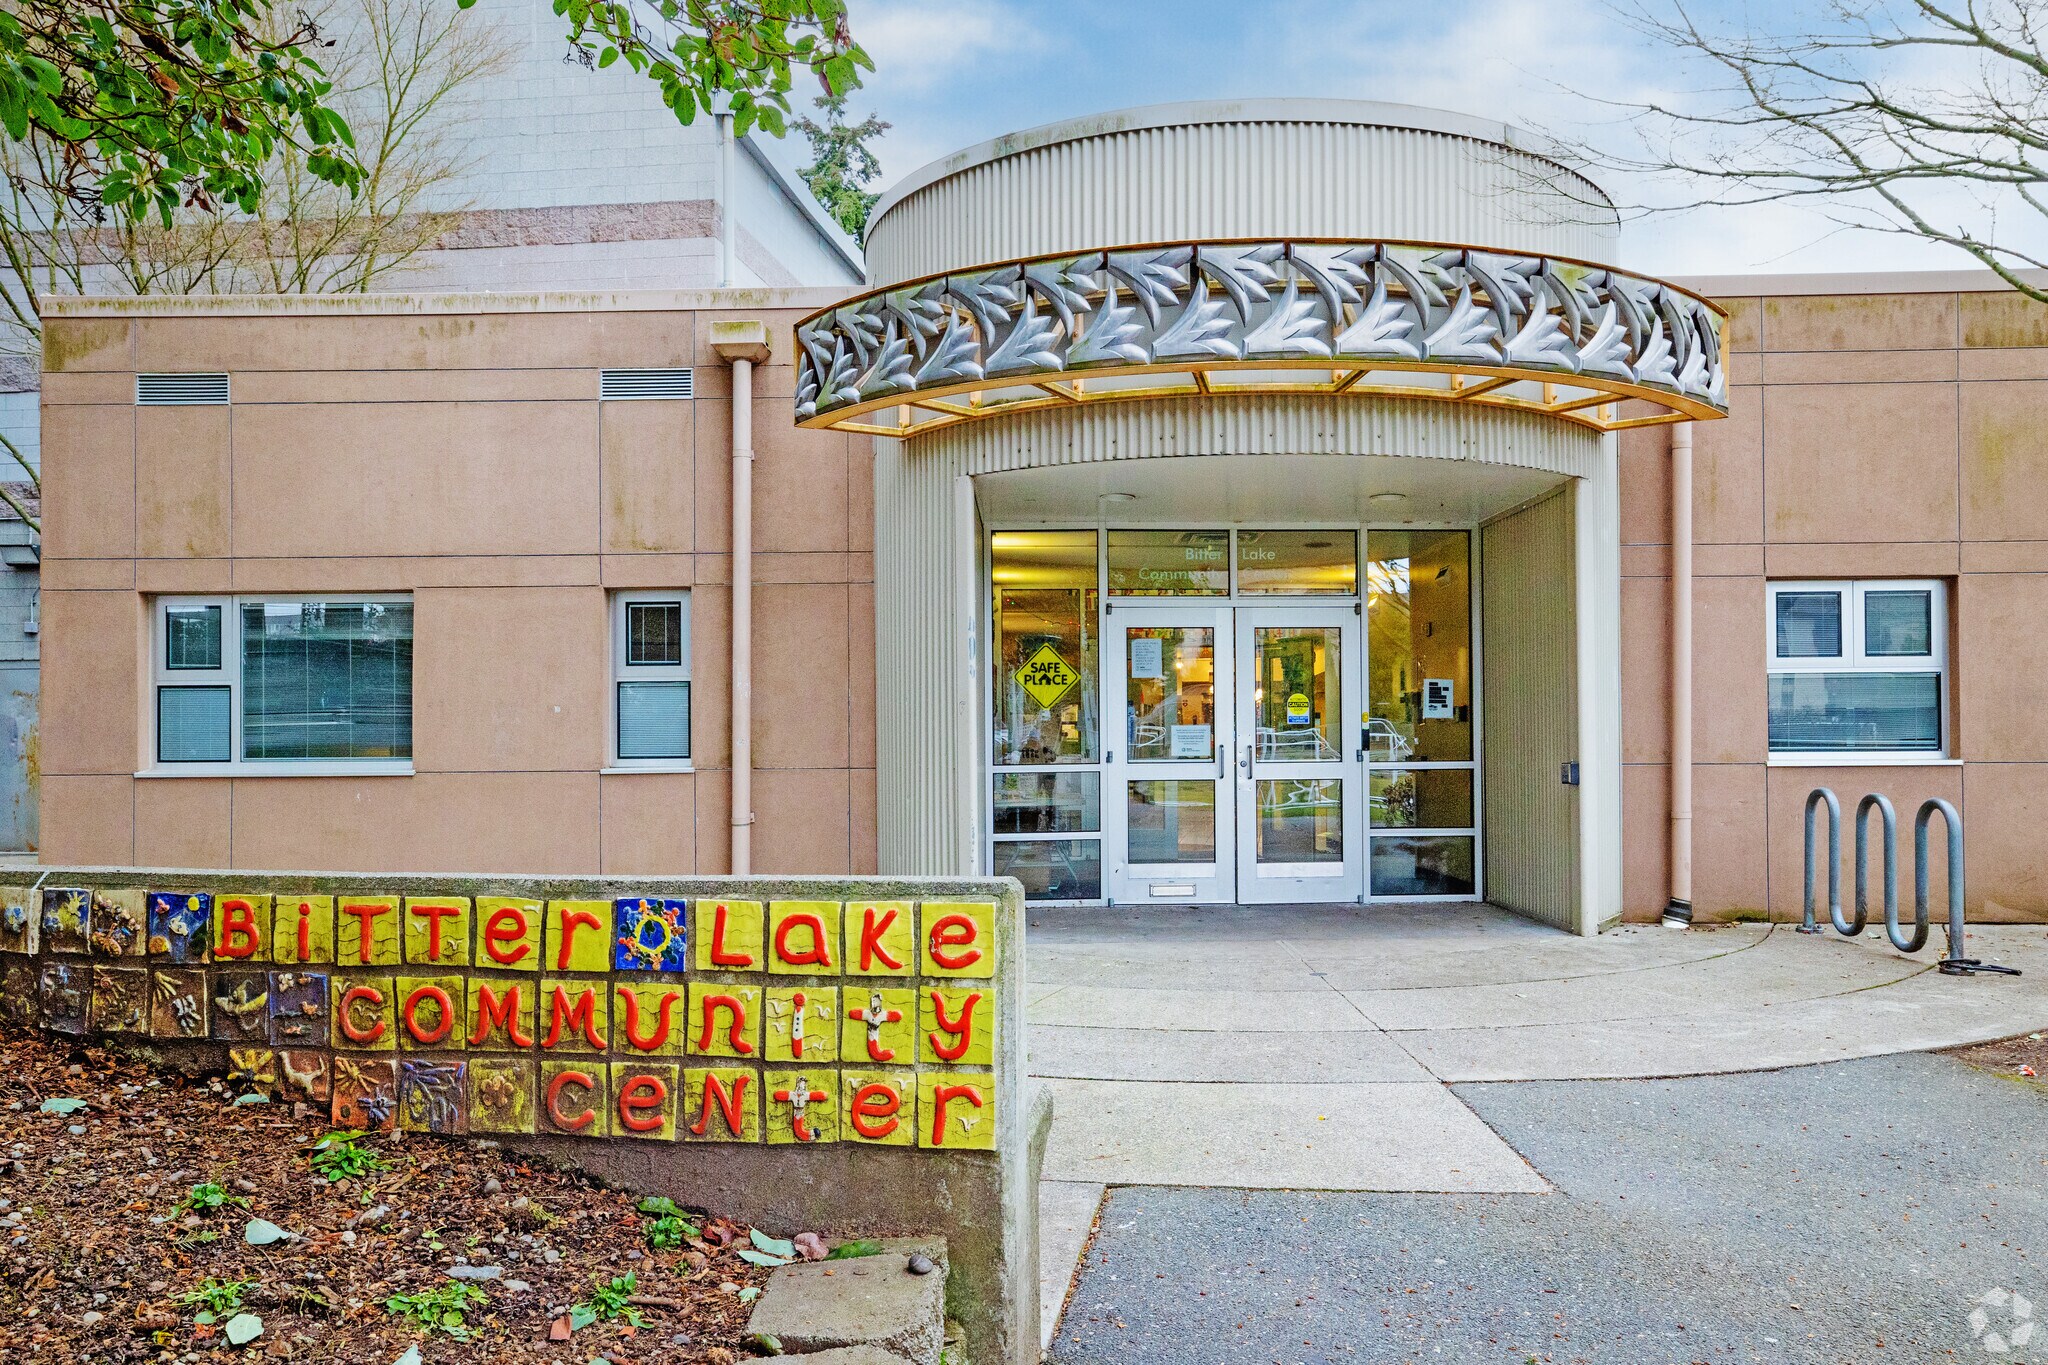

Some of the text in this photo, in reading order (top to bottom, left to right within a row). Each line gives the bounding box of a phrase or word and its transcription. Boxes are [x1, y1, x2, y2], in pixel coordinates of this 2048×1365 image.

[1185, 548, 1276, 561] Bitter Lake
[1030, 662, 1061, 673] SAFE
